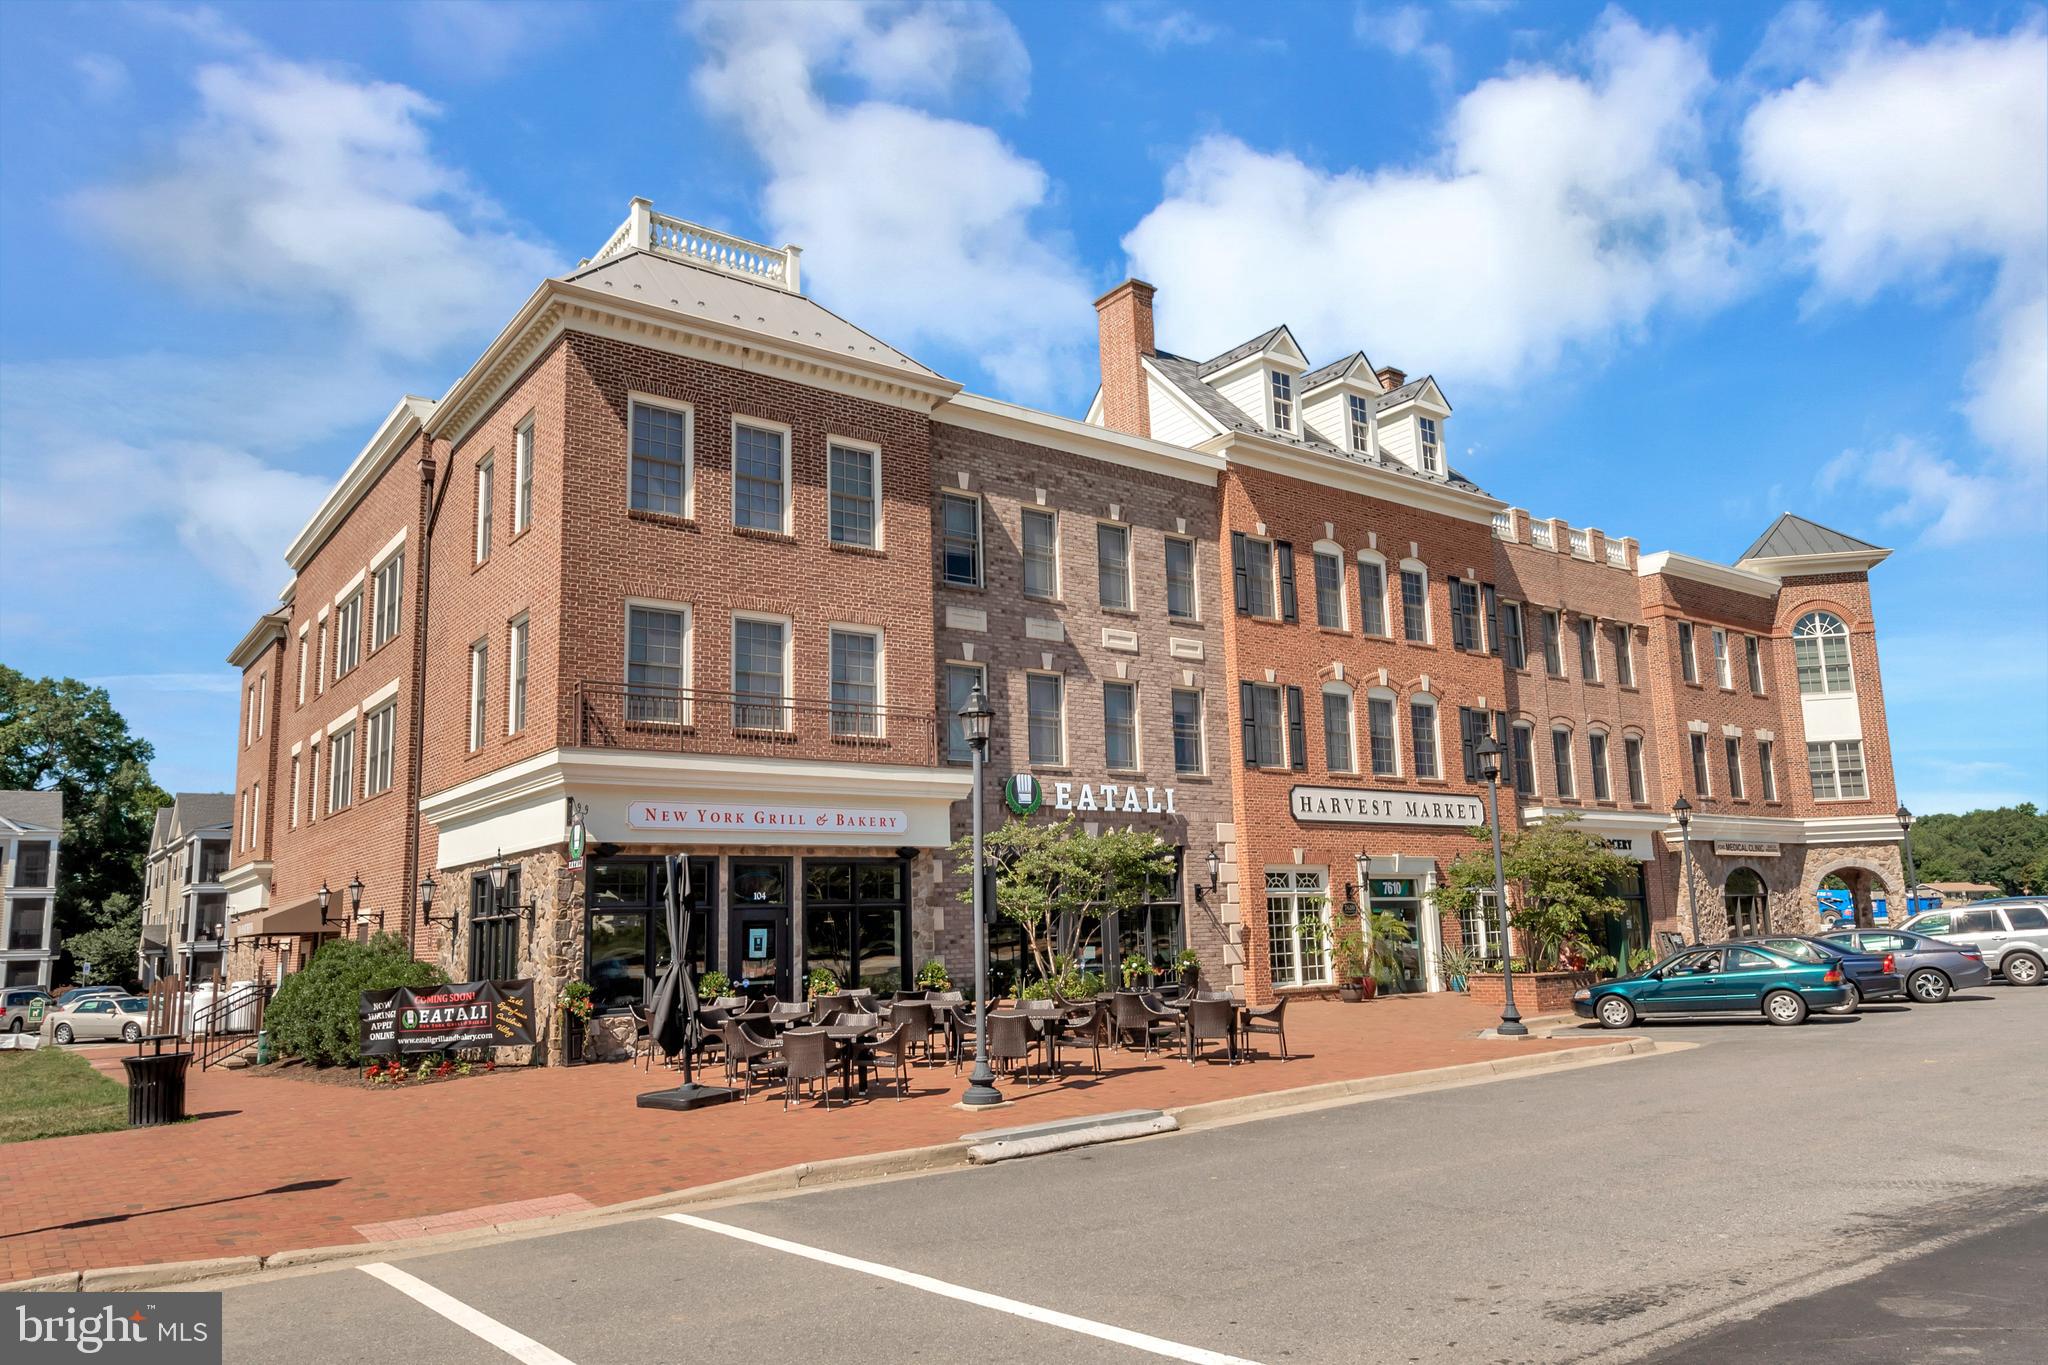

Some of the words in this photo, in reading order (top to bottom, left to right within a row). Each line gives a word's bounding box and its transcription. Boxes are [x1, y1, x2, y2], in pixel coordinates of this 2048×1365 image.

[1055, 783, 1176, 814] EATALI
[1299, 796, 1393, 816] HARVEST
[1405, 801, 1477, 820] MARKET
[644, 808, 688, 822] NEW
[697, 809, 745, 824] YORK
[754, 810, 806, 825] GRILL
[816, 813, 828, 826] &
[836, 814, 897, 828] BAKERY
[1726, 843, 1748, 851] MEDICAL
[1748, 844, 1764, 852] CLINIC
[1382, 881, 1401, 895] 7610
[753, 891, 766, 900] 104
[415, 993, 448, 1005] COMING
[449, 992, 475, 1002] SOON!
[373, 1000, 393, 1011] NOW
[419, 1005, 487, 1023] EATALI
[371, 1021, 393, 1031] APPLY
[369, 1031, 395, 1041] ONLINE
